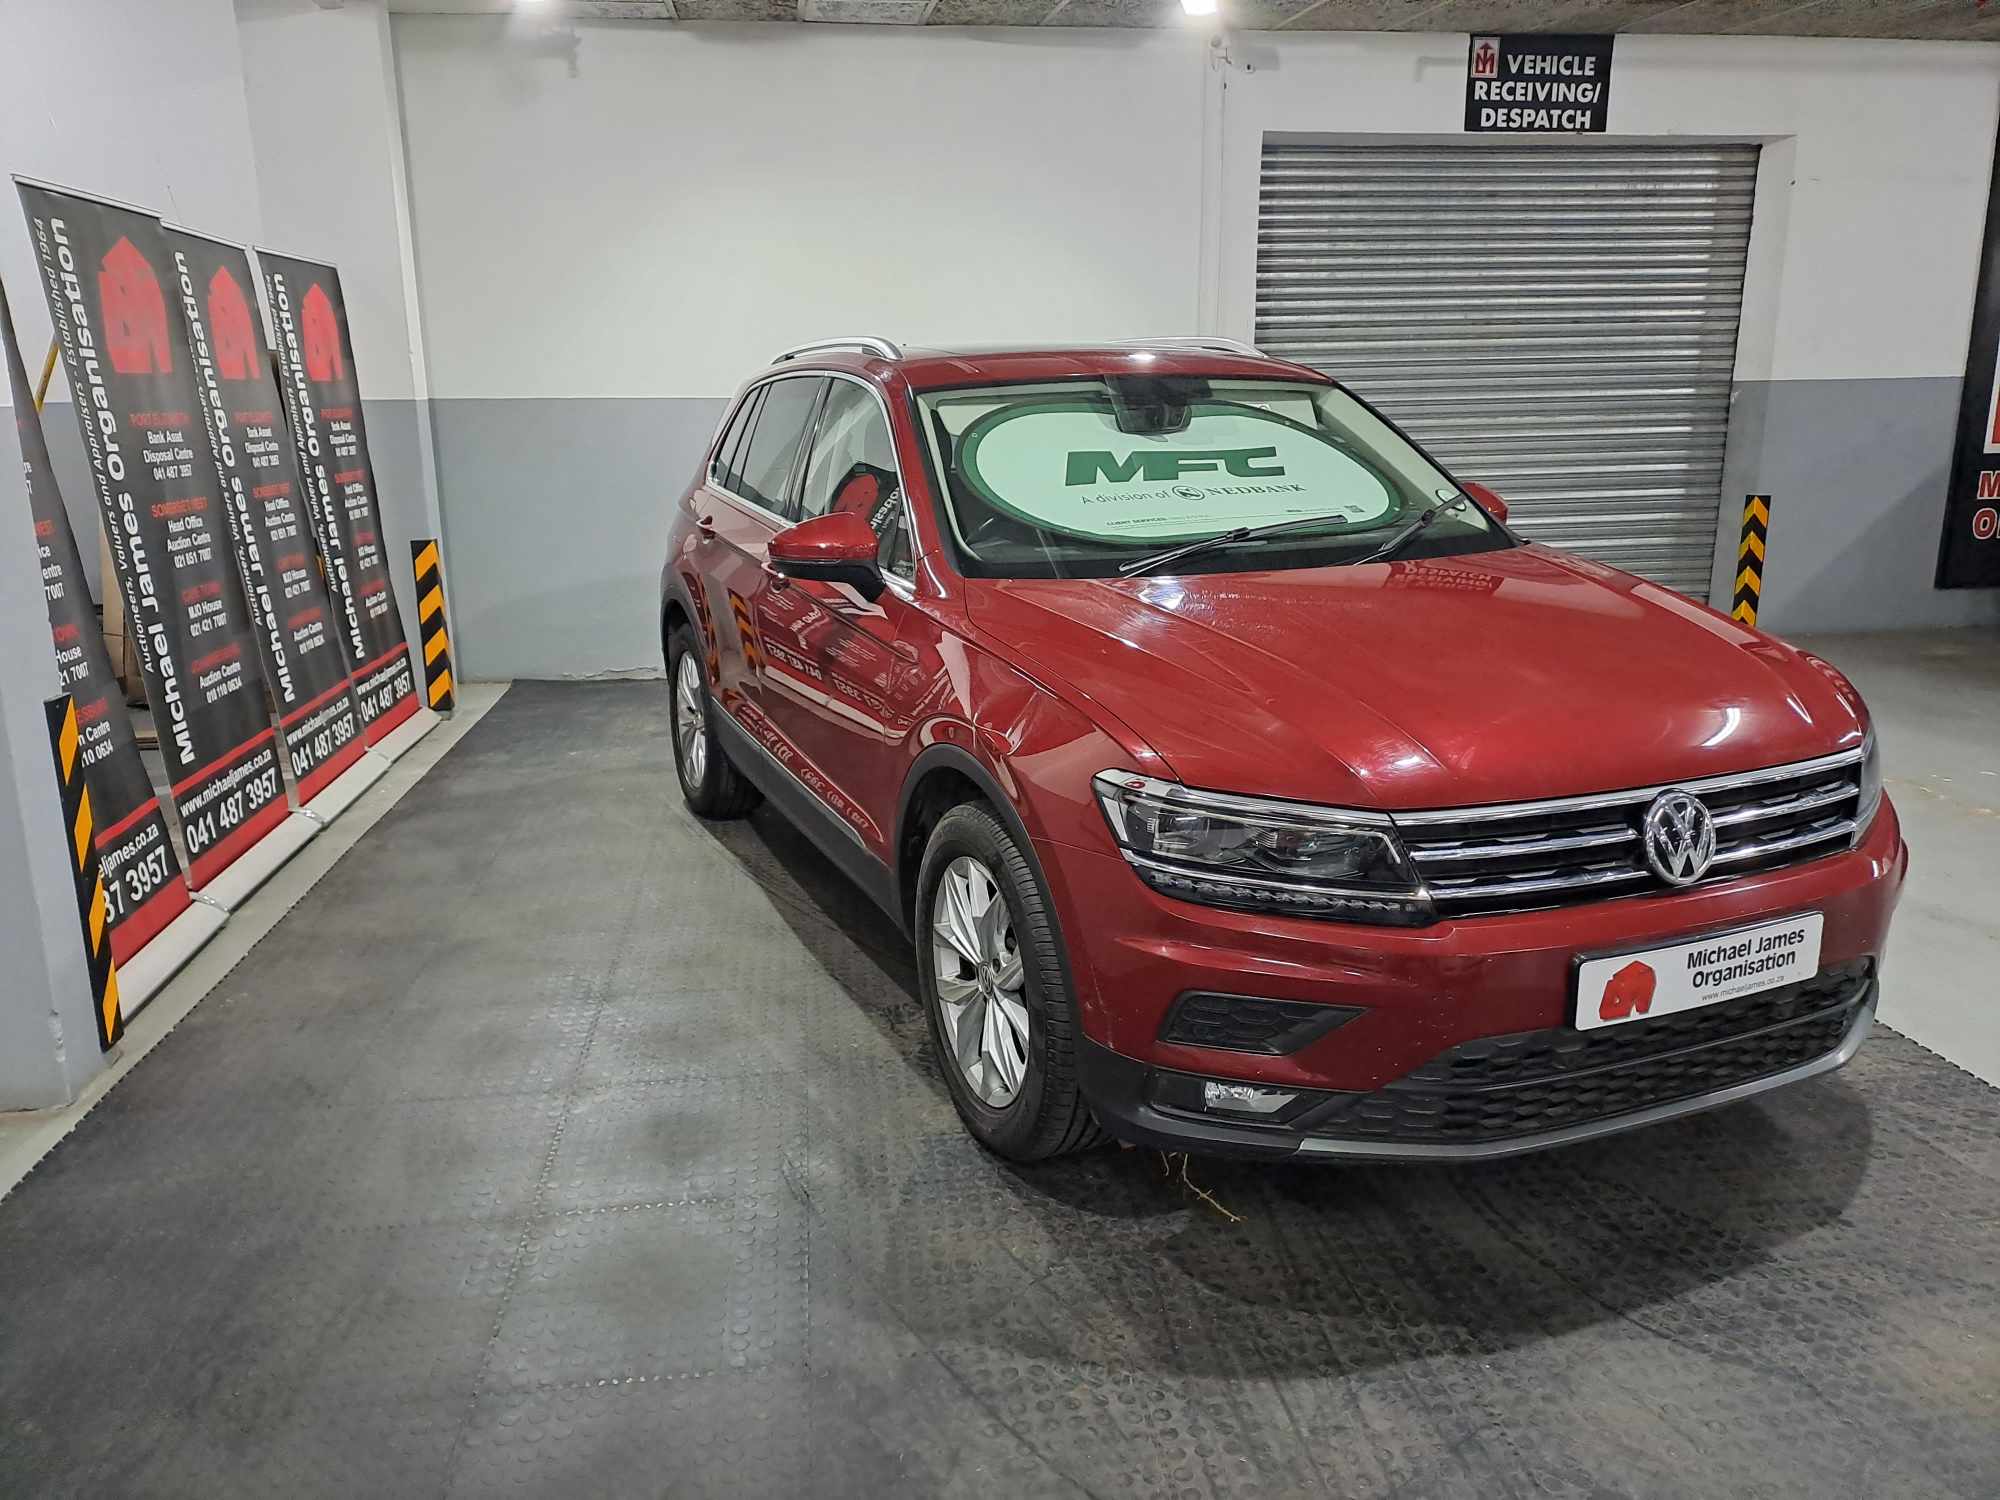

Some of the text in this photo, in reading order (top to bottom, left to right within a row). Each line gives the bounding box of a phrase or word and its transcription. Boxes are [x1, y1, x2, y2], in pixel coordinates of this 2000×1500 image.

[1474, 80, 1602, 103] RECEIVING/
[1508, 55, 1596, 76] VEHICLE
[1480, 108, 1592, 129] DESPATCH
[33, 216, 51, 261] 1964
[44, 265, 78, 367] Established
[174, 251, 235, 467] Organisation
[273, 273, 320, 457] Organisation
[75, 381, 104, 471] Appraisers
[50, 218, 195, 765] Michael James Organisation
[96, 473, 112, 506] and
[1065, 446, 1286, 486] MFC
[1096, 490, 1152, 504] division
[1155, 489, 1171, 499] of
[1205, 482, 1307, 496] NEDBANK
[1977, 470, 2000, 500] M
[231, 476, 264, 576] James
[315, 465, 341, 550] James
[107, 510, 128, 571] Valuers
[42, 564, 63, 580] entre
[333, 557, 365, 659] Michael
[256, 585, 296, 703] Michael
[360, 671, 411, 722] 041 487 3957
[86, 720, 111, 742] Centre
[291, 712, 355, 776] 041 487 3957
[186, 767, 277, 854] 041 487 3957
[98, 823, 159, 879] eljames.co.za
[126, 844, 168, 900] 3957
[1687, 929, 1805, 970] Michael James
[1692, 951, 1796, 988] Organisation
